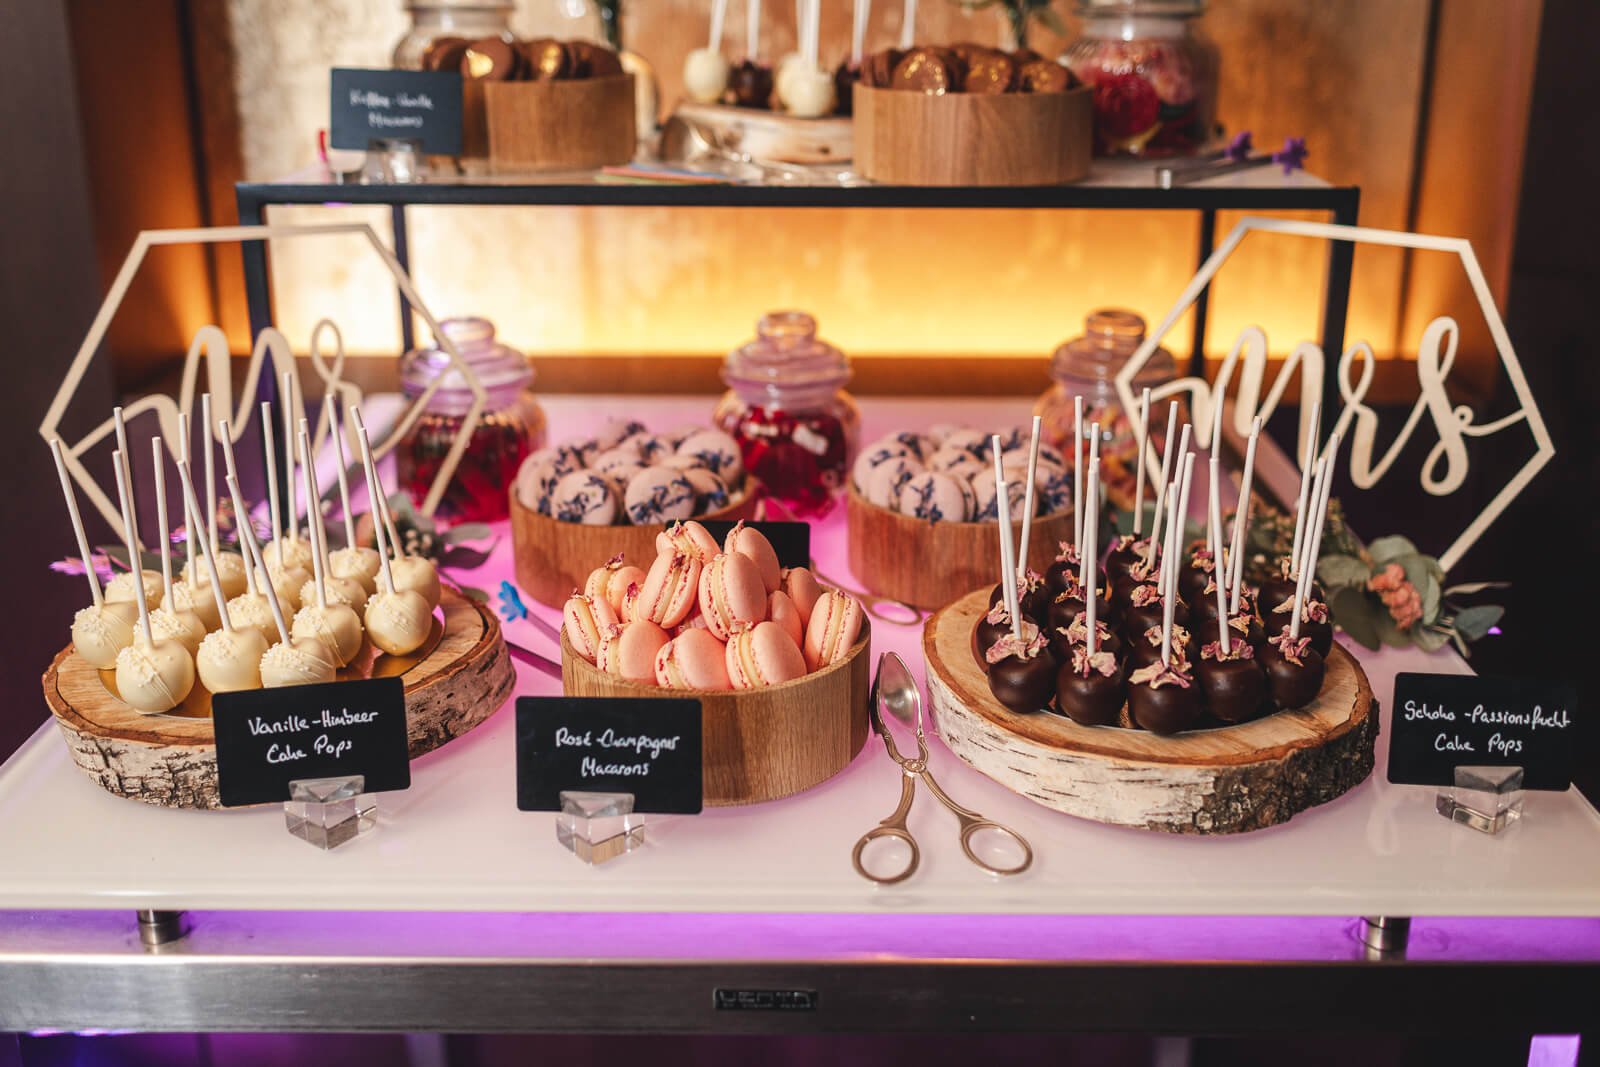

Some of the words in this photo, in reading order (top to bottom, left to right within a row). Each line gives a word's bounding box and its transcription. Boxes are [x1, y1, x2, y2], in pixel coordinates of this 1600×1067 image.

[248, 708, 378, 735] Vanille-Himbeer
[266, 743, 307, 764] Cake
[313, 734, 352, 759] Pops
[1434, 733, 1475, 751] Cake
[1488, 732, 1523, 756] Pops
[581, 756, 649, 777] Macarons
